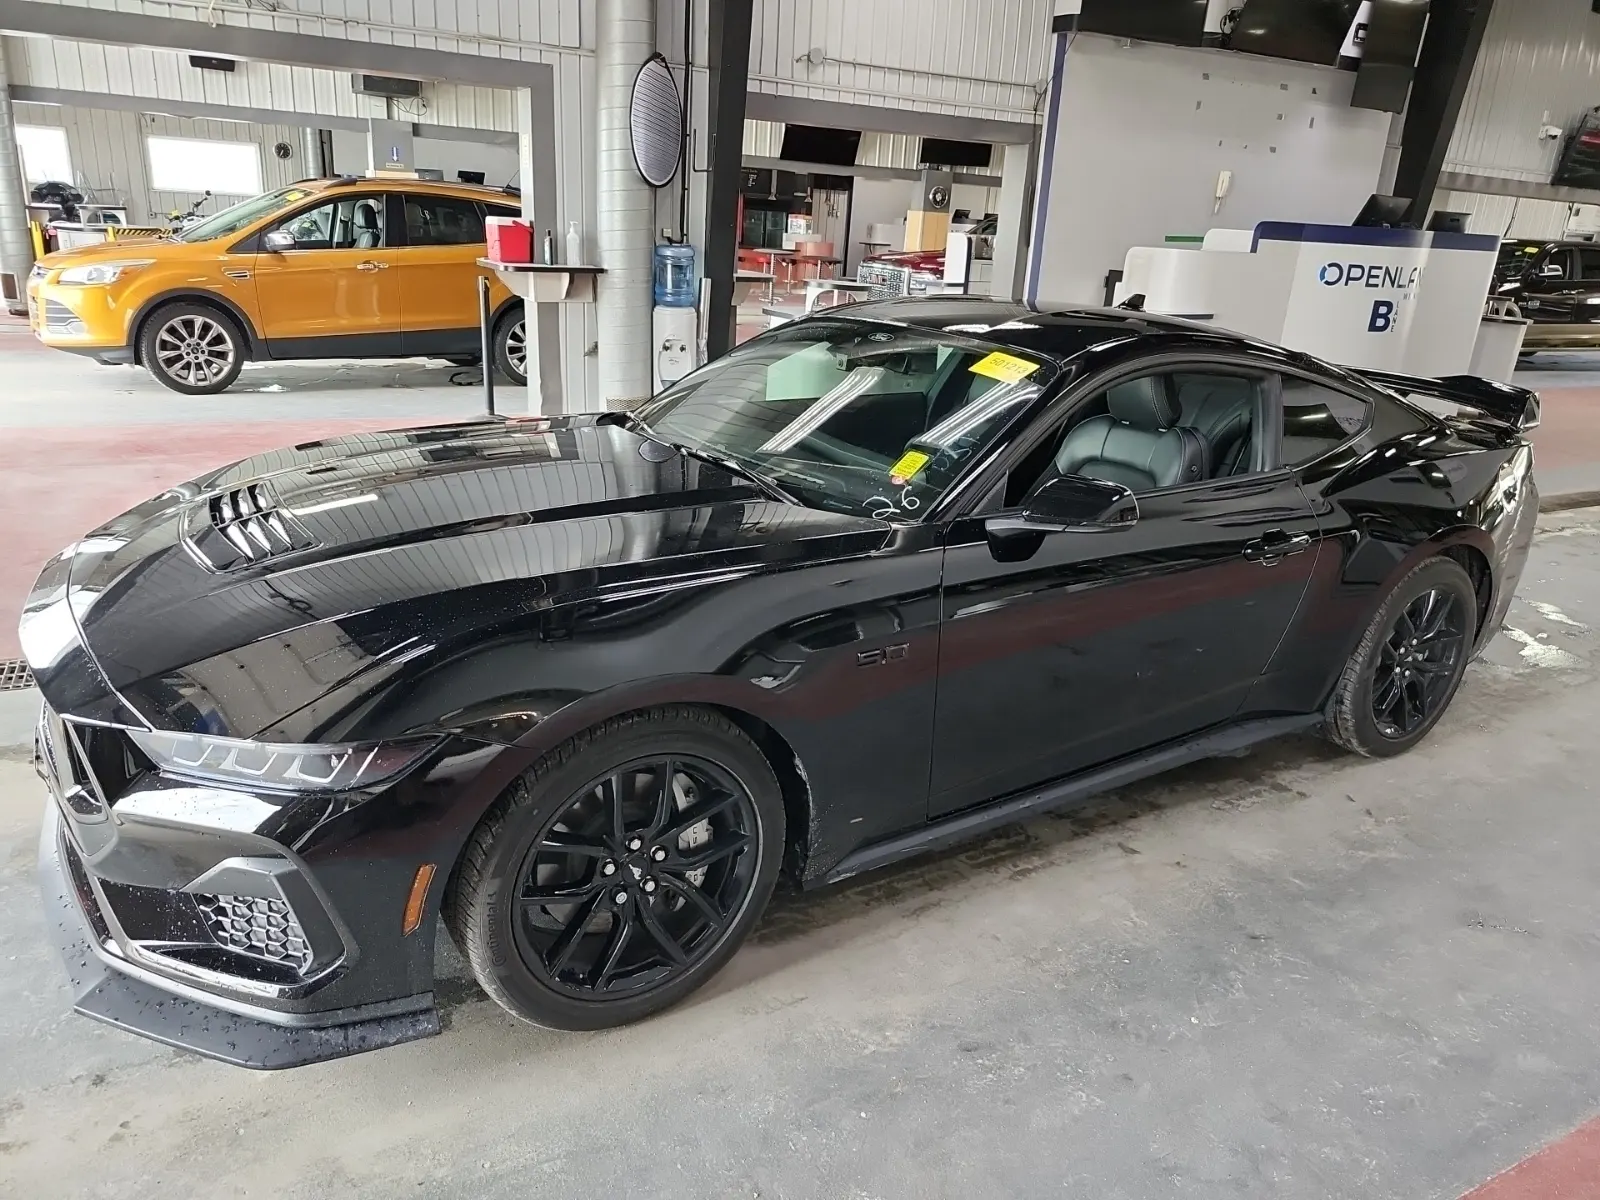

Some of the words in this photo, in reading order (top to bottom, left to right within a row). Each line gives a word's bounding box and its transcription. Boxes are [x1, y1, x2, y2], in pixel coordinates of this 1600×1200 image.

[1367, 300, 1394, 332] B
[862, 486, 920, 519] 26
[857, 642, 910, 667] 5.0
[486, 902, 507, 967] Continental
